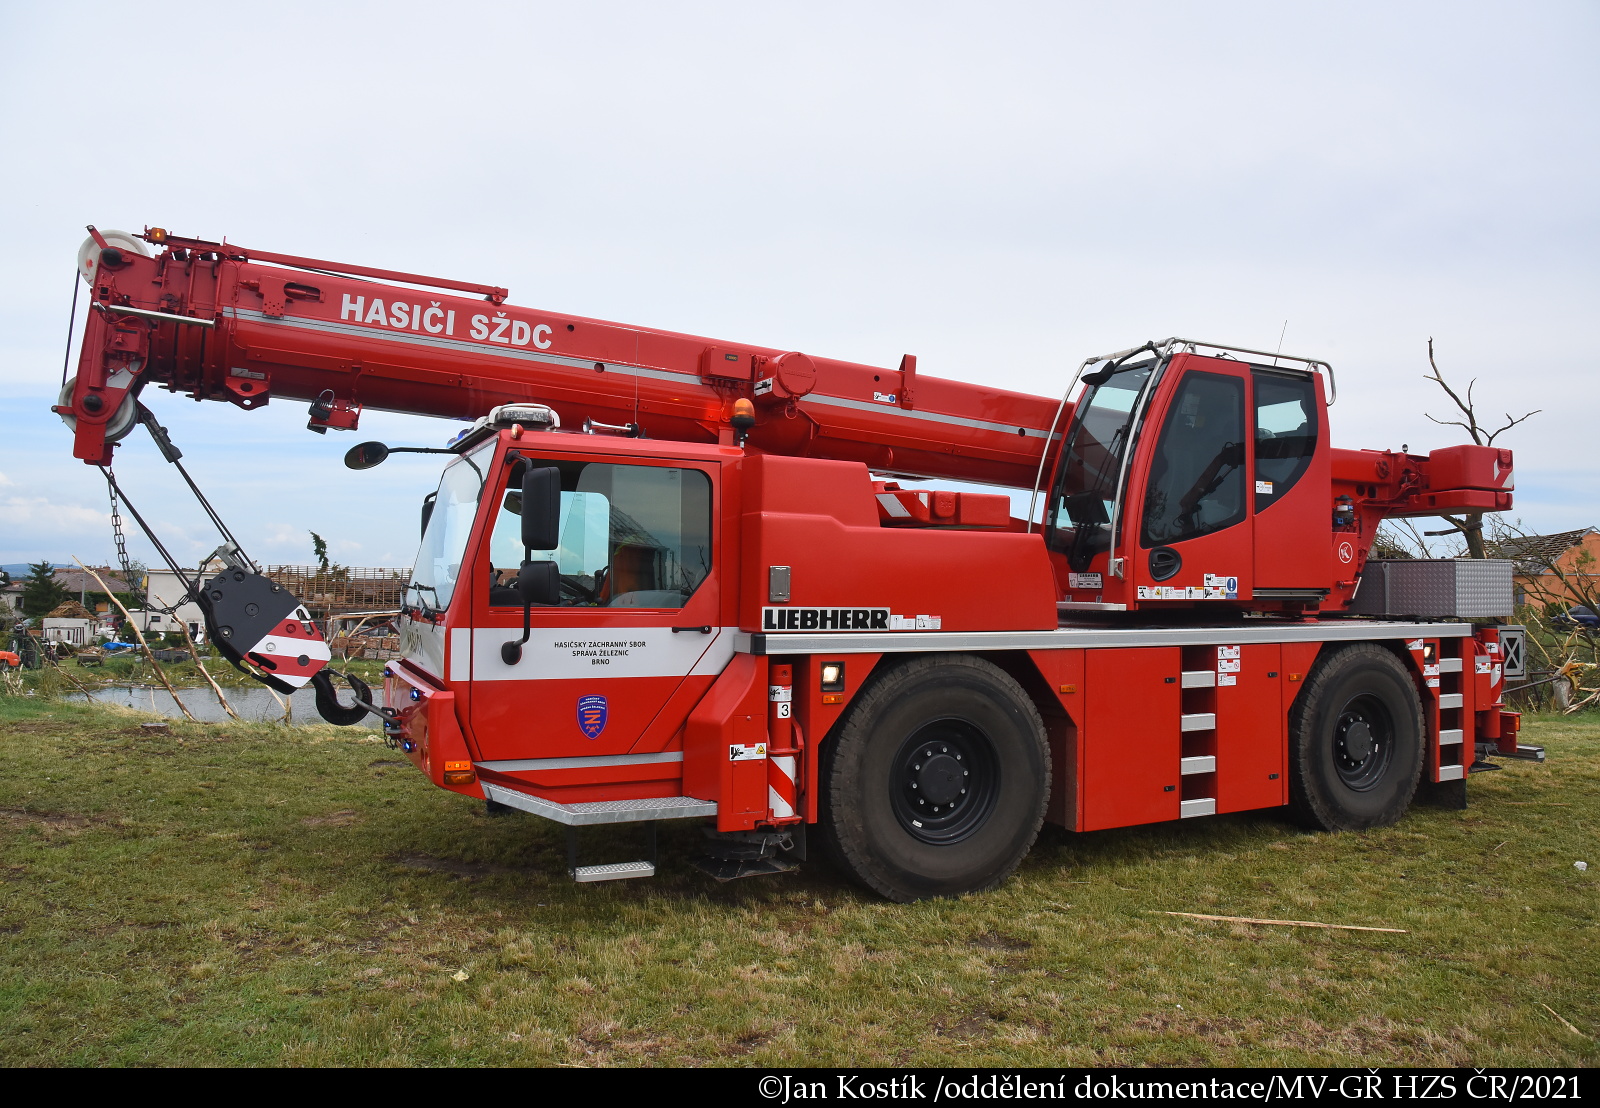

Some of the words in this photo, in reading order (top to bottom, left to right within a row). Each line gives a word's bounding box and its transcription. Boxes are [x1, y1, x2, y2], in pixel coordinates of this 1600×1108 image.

[340, 293, 455, 336] HASIČI
[469, 311, 553, 349] SŽDC
[764, 609, 888, 630] LIEBHERR
[781, 704, 789, 717] 3
